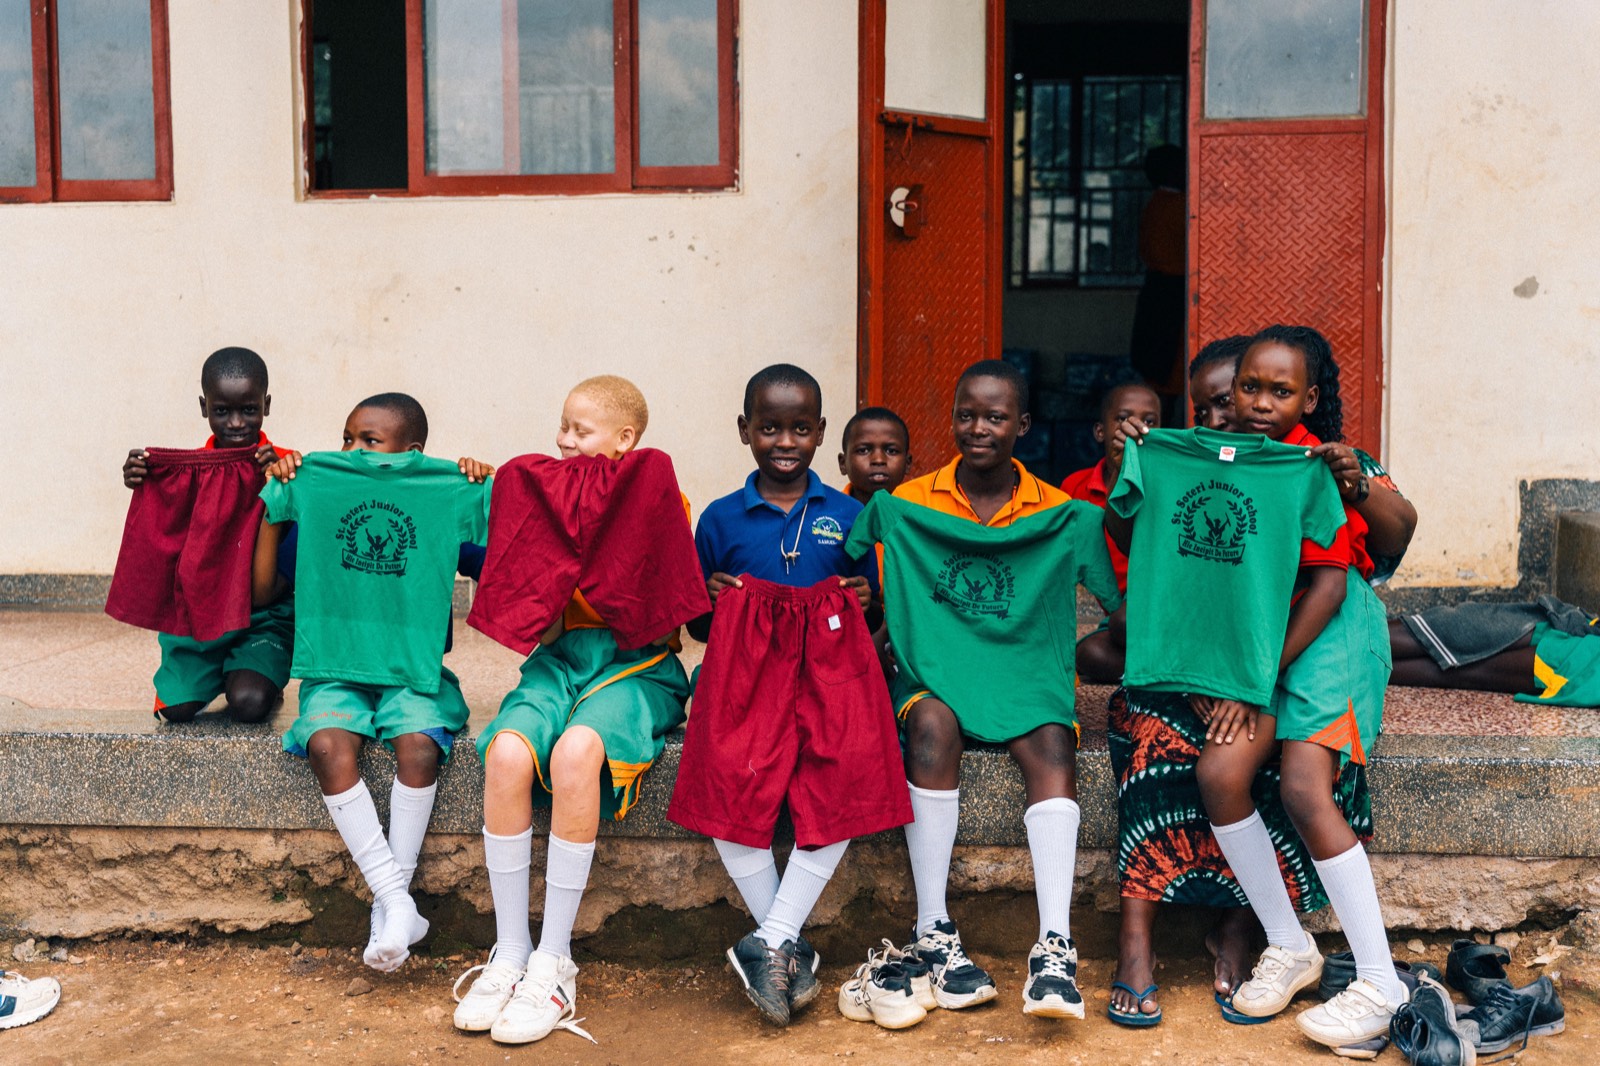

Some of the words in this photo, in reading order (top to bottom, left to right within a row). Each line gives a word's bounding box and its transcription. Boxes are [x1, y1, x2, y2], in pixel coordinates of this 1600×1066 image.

[340, 501, 368, 525] Soteri
[370, 499, 405, 517] Junior
[403, 515, 418, 550] School
[1176, 481, 1206, 508] Soteri
[1208, 479, 1245, 499] Junior
[1242, 497, 1258, 535] School
[1002, 565, 1016, 598] School
